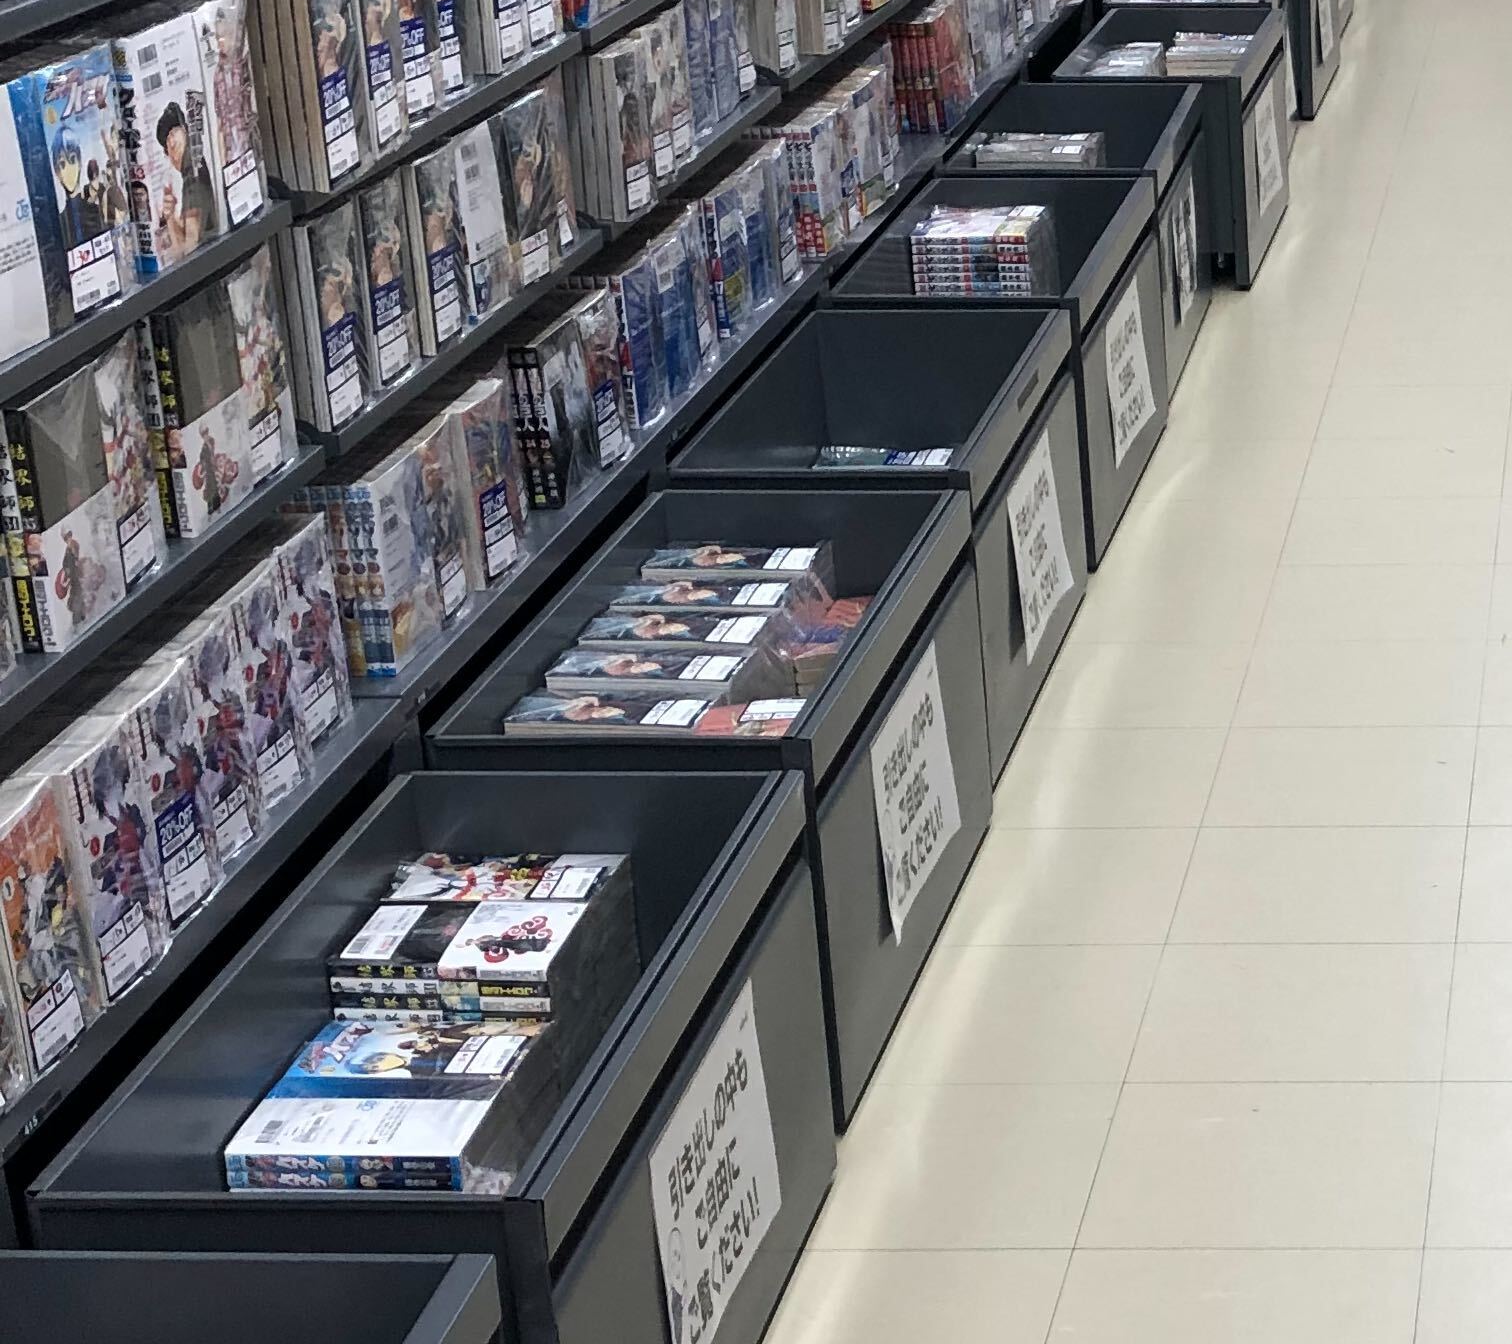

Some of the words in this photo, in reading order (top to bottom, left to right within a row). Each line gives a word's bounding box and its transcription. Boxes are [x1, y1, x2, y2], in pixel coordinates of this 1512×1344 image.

[159, 803, 192, 845] 20%OFF
[668, 1047, 749, 1223] 引き出しの中も
[694, 1136, 741, 1251] ご自由に
